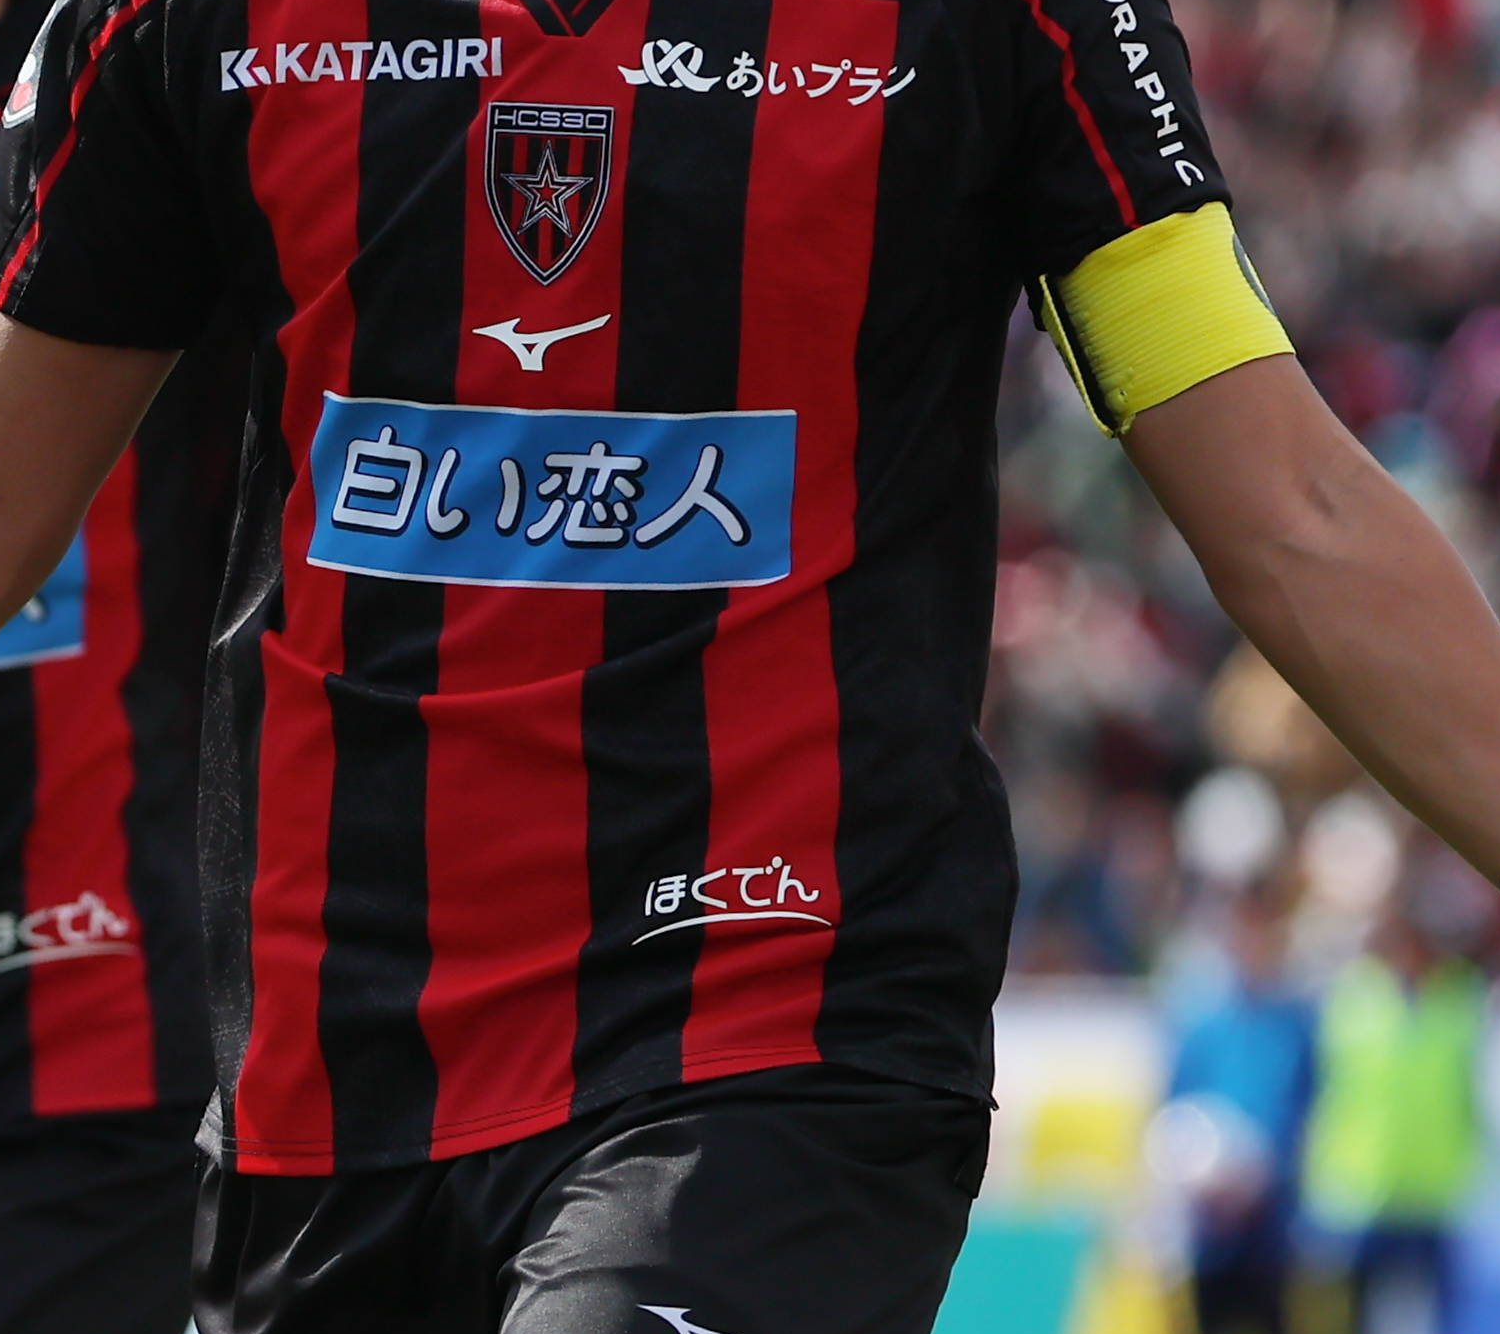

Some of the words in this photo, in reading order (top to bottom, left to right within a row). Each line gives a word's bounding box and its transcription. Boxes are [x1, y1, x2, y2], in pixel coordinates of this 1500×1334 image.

[275, 36, 503, 84] KATAGIRI
[725, 50, 917, 106] あいプラン
[494, 108, 608, 131] HCS30
[331, 424, 751, 549] 白い恋人
[644, 855, 820, 917] ほくでん
